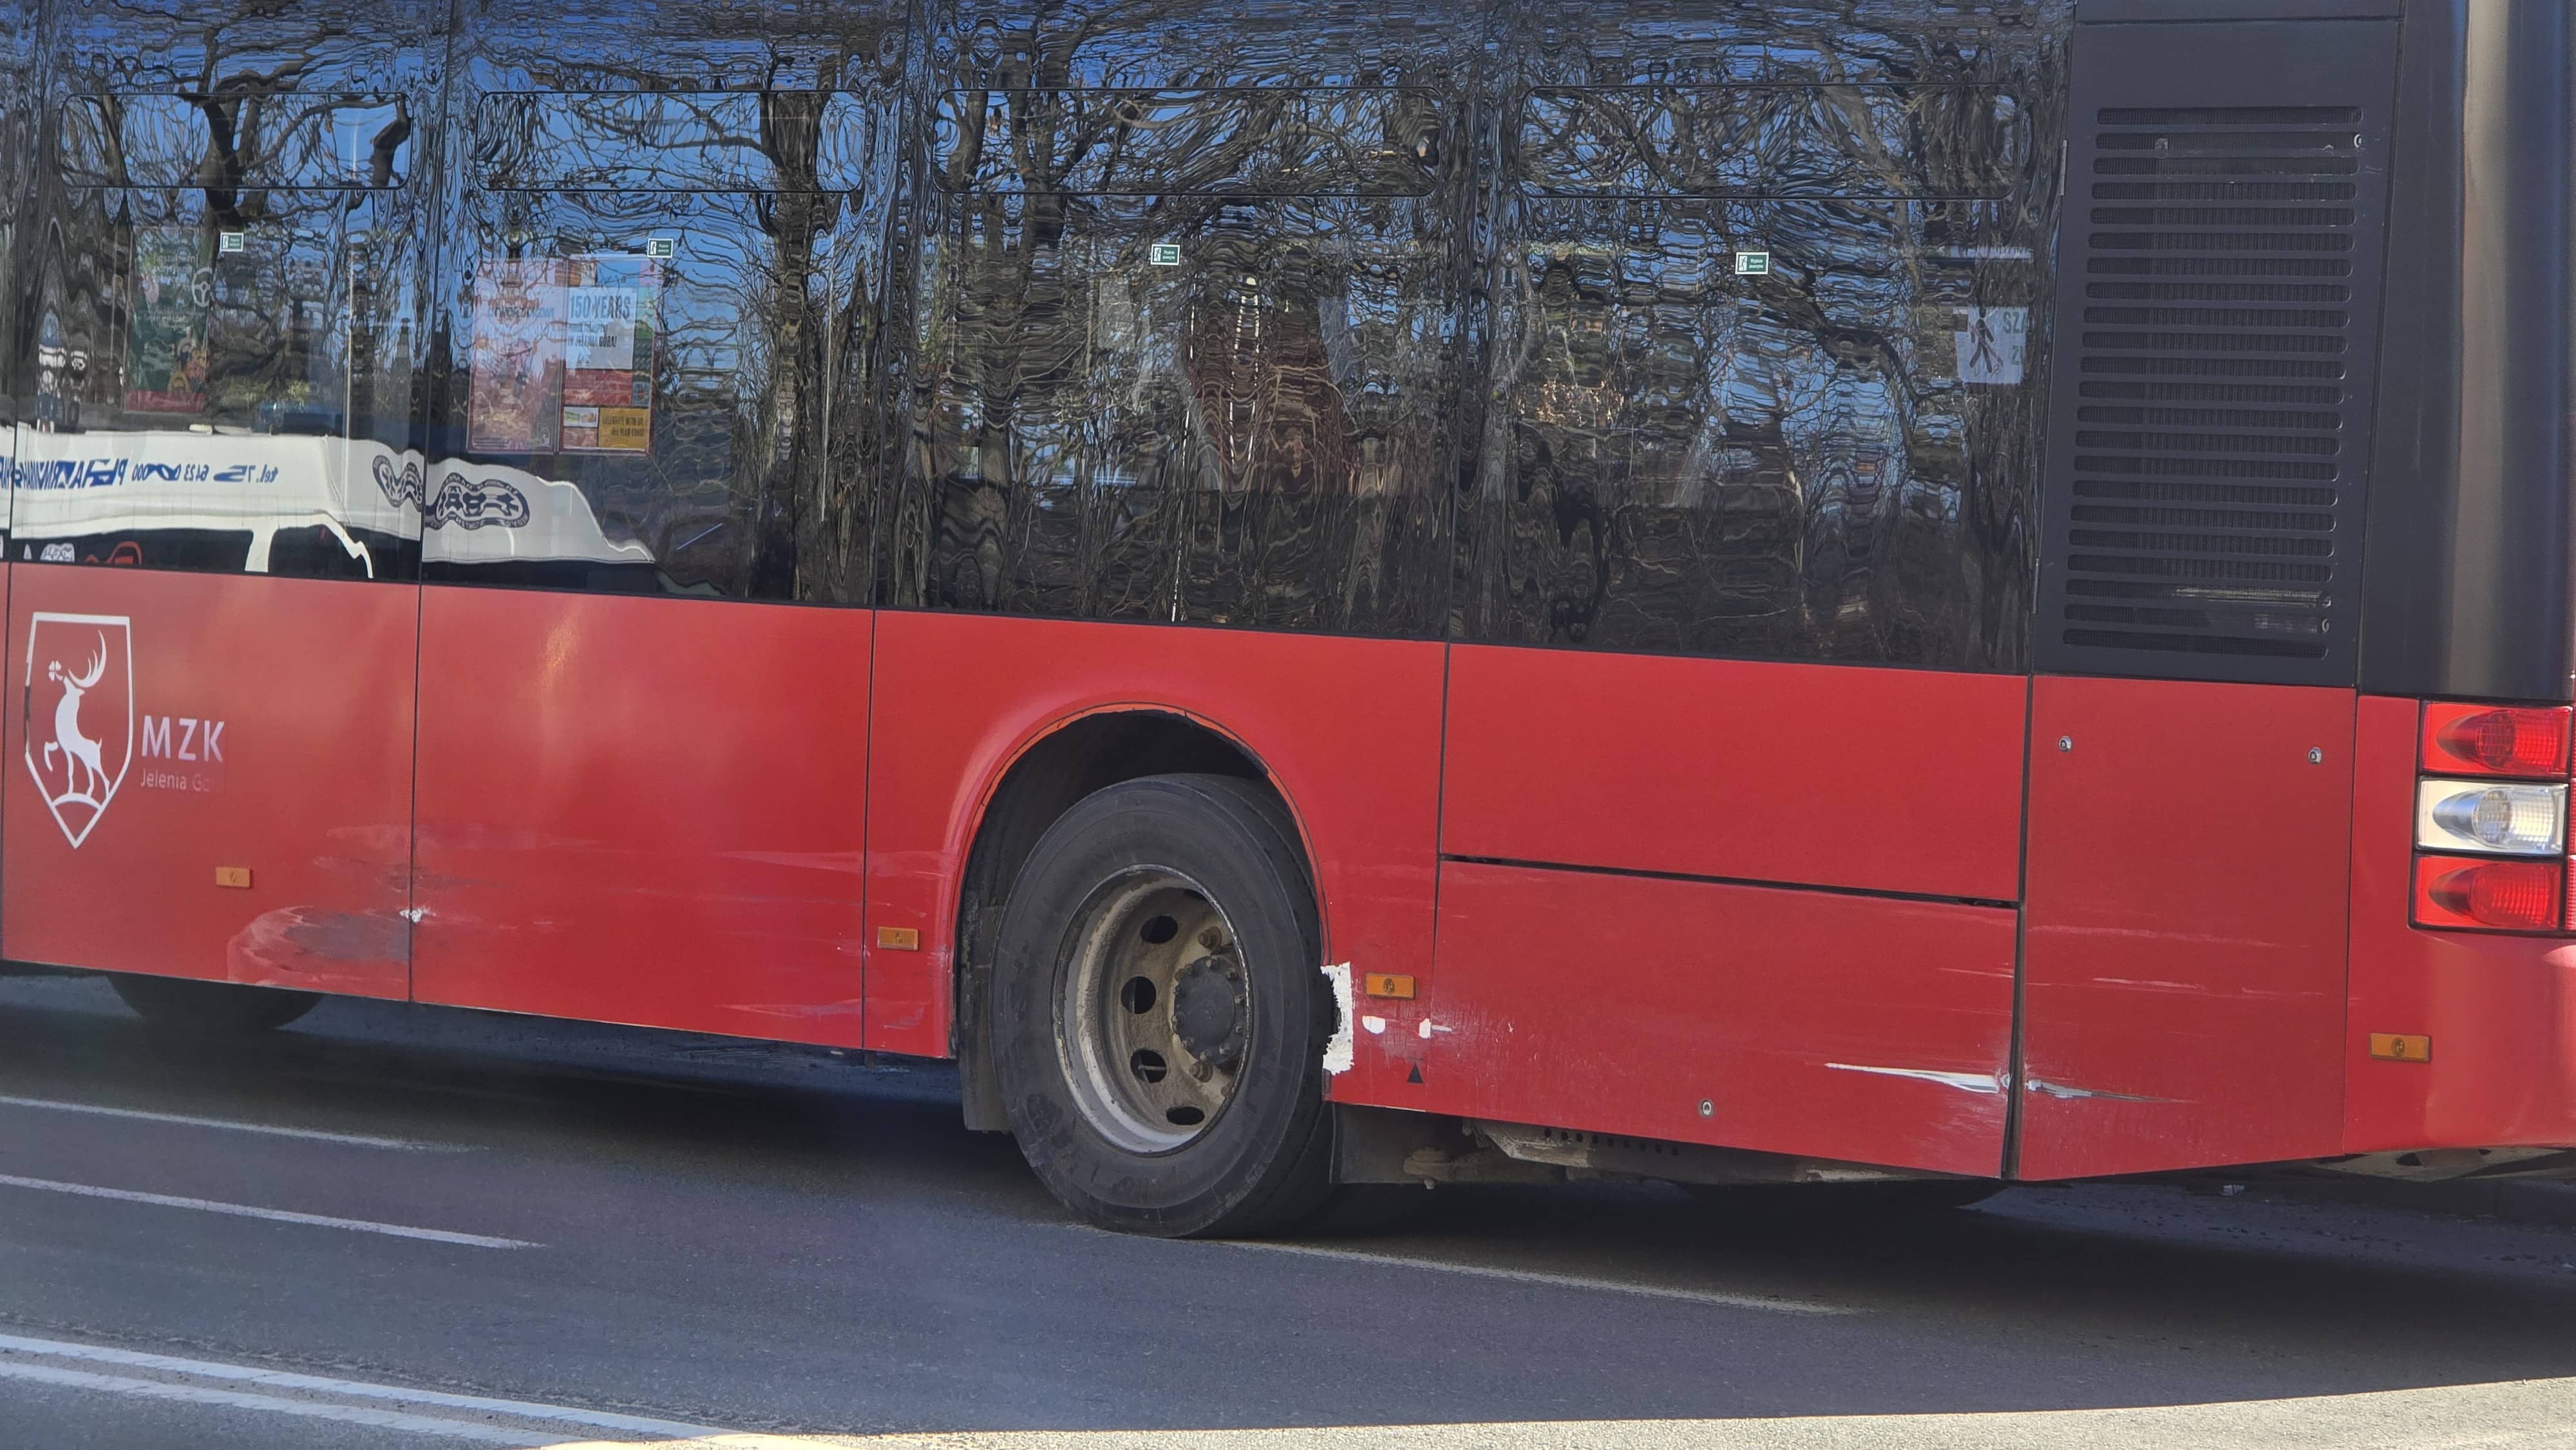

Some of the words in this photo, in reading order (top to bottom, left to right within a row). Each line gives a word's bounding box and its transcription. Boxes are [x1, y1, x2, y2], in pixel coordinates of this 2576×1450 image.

[570, 295, 591, 319] 150
[592, 295, 631, 320] YEARS
[141, 715, 225, 763] MZK
[140, 767, 187, 790] Jelenia
